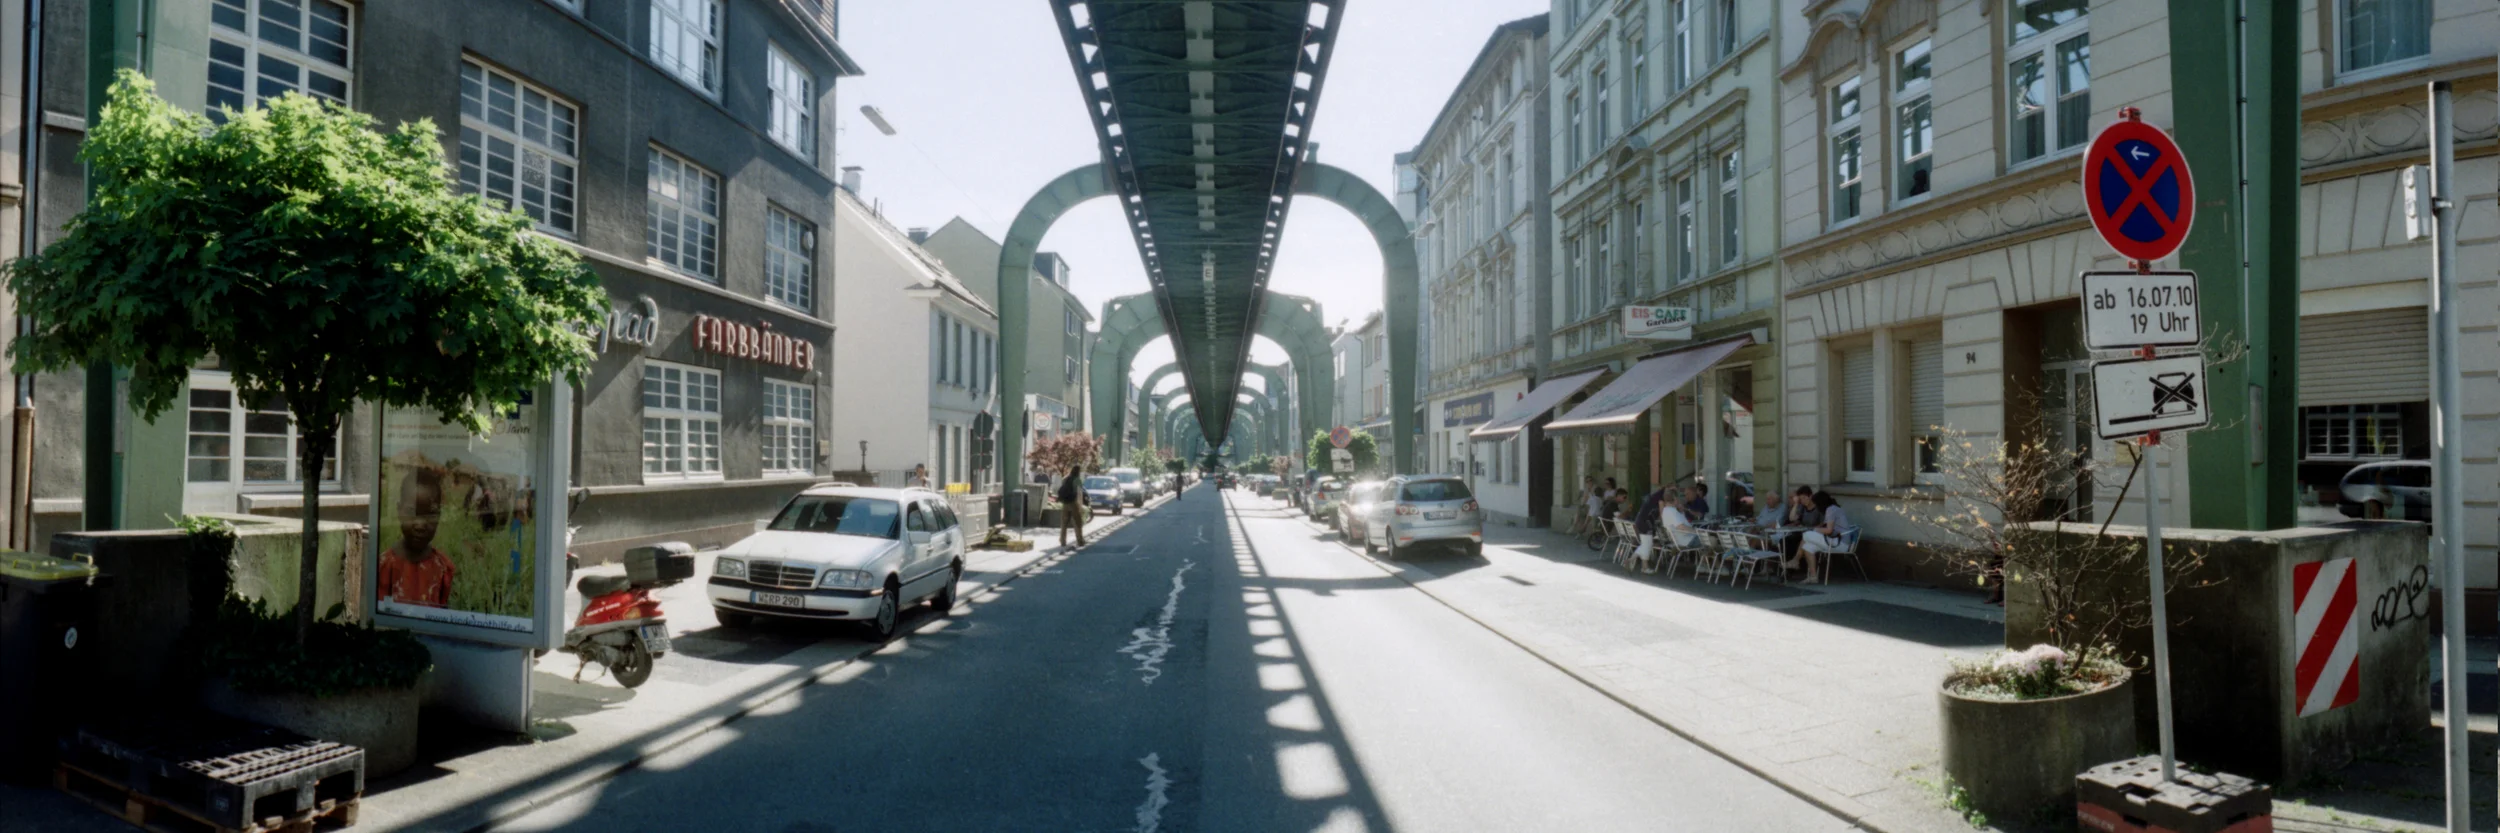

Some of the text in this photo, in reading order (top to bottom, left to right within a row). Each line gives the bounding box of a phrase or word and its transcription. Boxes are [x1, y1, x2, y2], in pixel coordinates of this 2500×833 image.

[2093, 286, 2193, 310] ab 16.07.10
[2130, 311, 2190, 334] 19 Uhr
[693, 313, 815, 372] FARBBÄNDER
[1965, 351, 1977, 365] 94
[782, 596, 800, 606] 290
